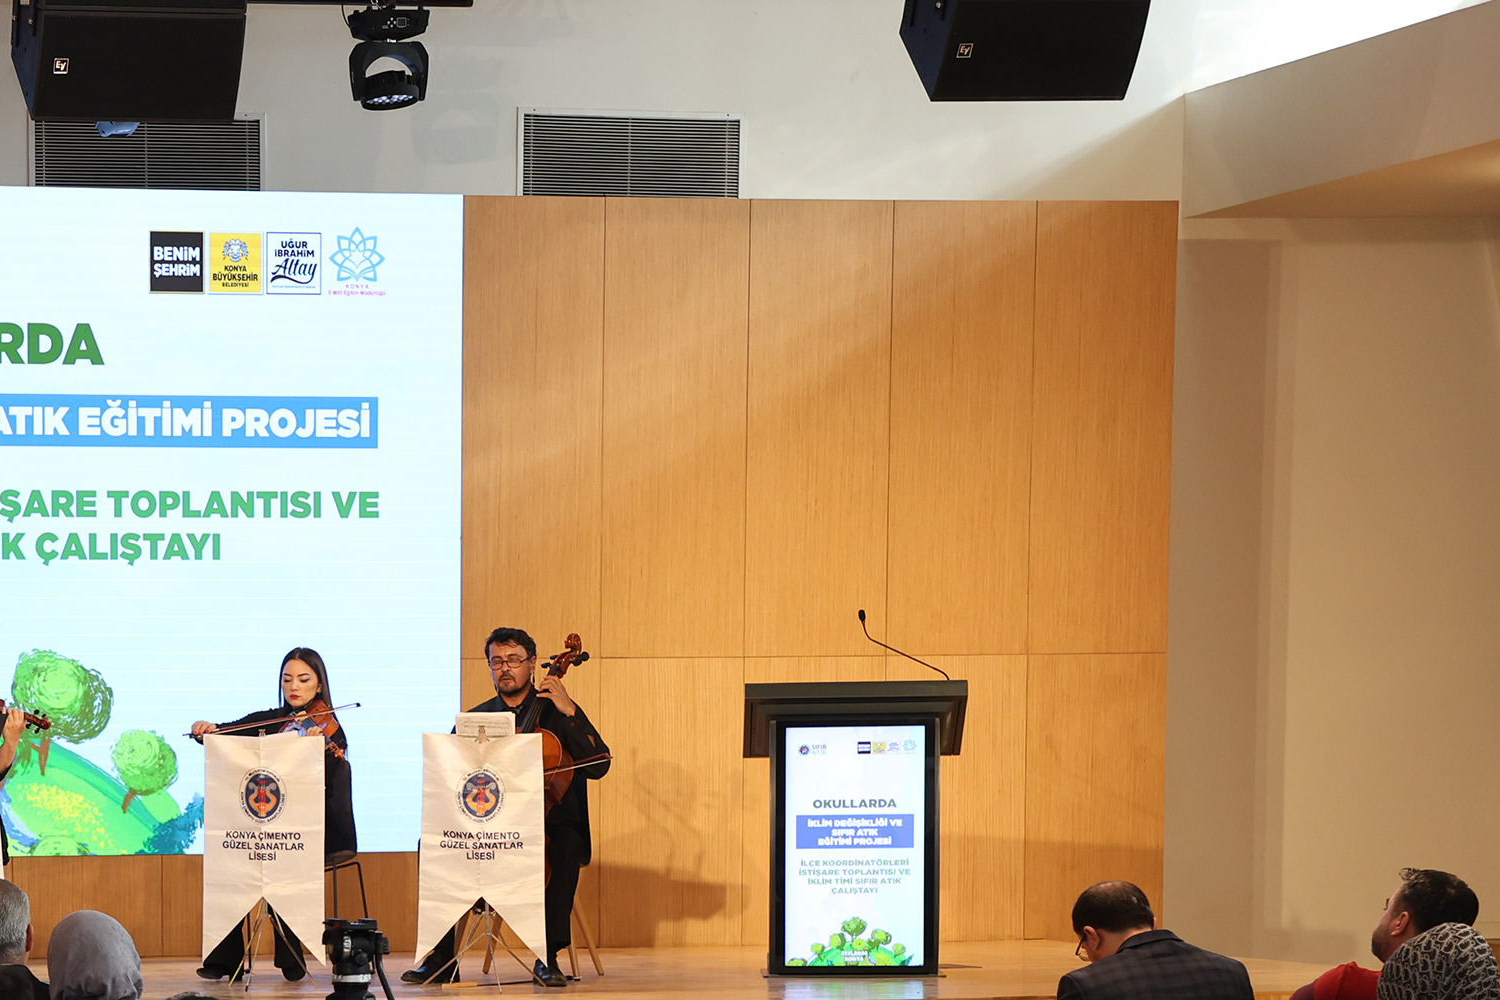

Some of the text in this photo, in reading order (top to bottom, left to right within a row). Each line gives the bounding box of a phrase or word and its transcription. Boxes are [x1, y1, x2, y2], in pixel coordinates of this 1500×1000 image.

[281, 238, 308, 249] UĞUR
[153, 246, 200, 261] BENİM
[274, 249, 315, 258] İBRAHİM
[153, 263, 200, 278] ŞEHRİM
[271, 258, 317, 283] Altay
[212, 272, 258, 282] BÜYÜKŞEHİR
[78, 398, 213, 437] EĞİTİMİ
[221, 402, 370, 438] PROJESİ
[106, 490, 321, 518] TOPLANTISI
[331, 491, 380, 518] VE
[35, 532, 221, 566] ÇALIŞTAYI
[813, 798, 897, 809] OKULLARDA
[807, 818, 833, 828] İKLİM
[889, 818, 903, 827] VE
[225, 830, 301, 841] KONYA ÇİMENTO
[443, 830, 520, 841] KONYA ÇİMENTO
[831, 828, 879, 836] SIFIR ATIK
[222, 839, 304, 851] GÜZEL SANATLAR
[440, 839, 524, 850] GÜZEL SANATLAR
[853, 836, 892, 845] PROJESİ
[248, 851, 276, 861] LİSESİ
[466, 850, 495, 860] LİSESİ
[800, 858, 909, 867] İLÇE KOORDİNATÖRLERİ
[799, 868, 911, 877] İSTİŞARE TOPLANTISI VE
[807, 877, 832, 885] İKLİM
[834, 877, 853, 885] TİMİ
[831, 887, 878, 895] ÇALIŞTAYI
